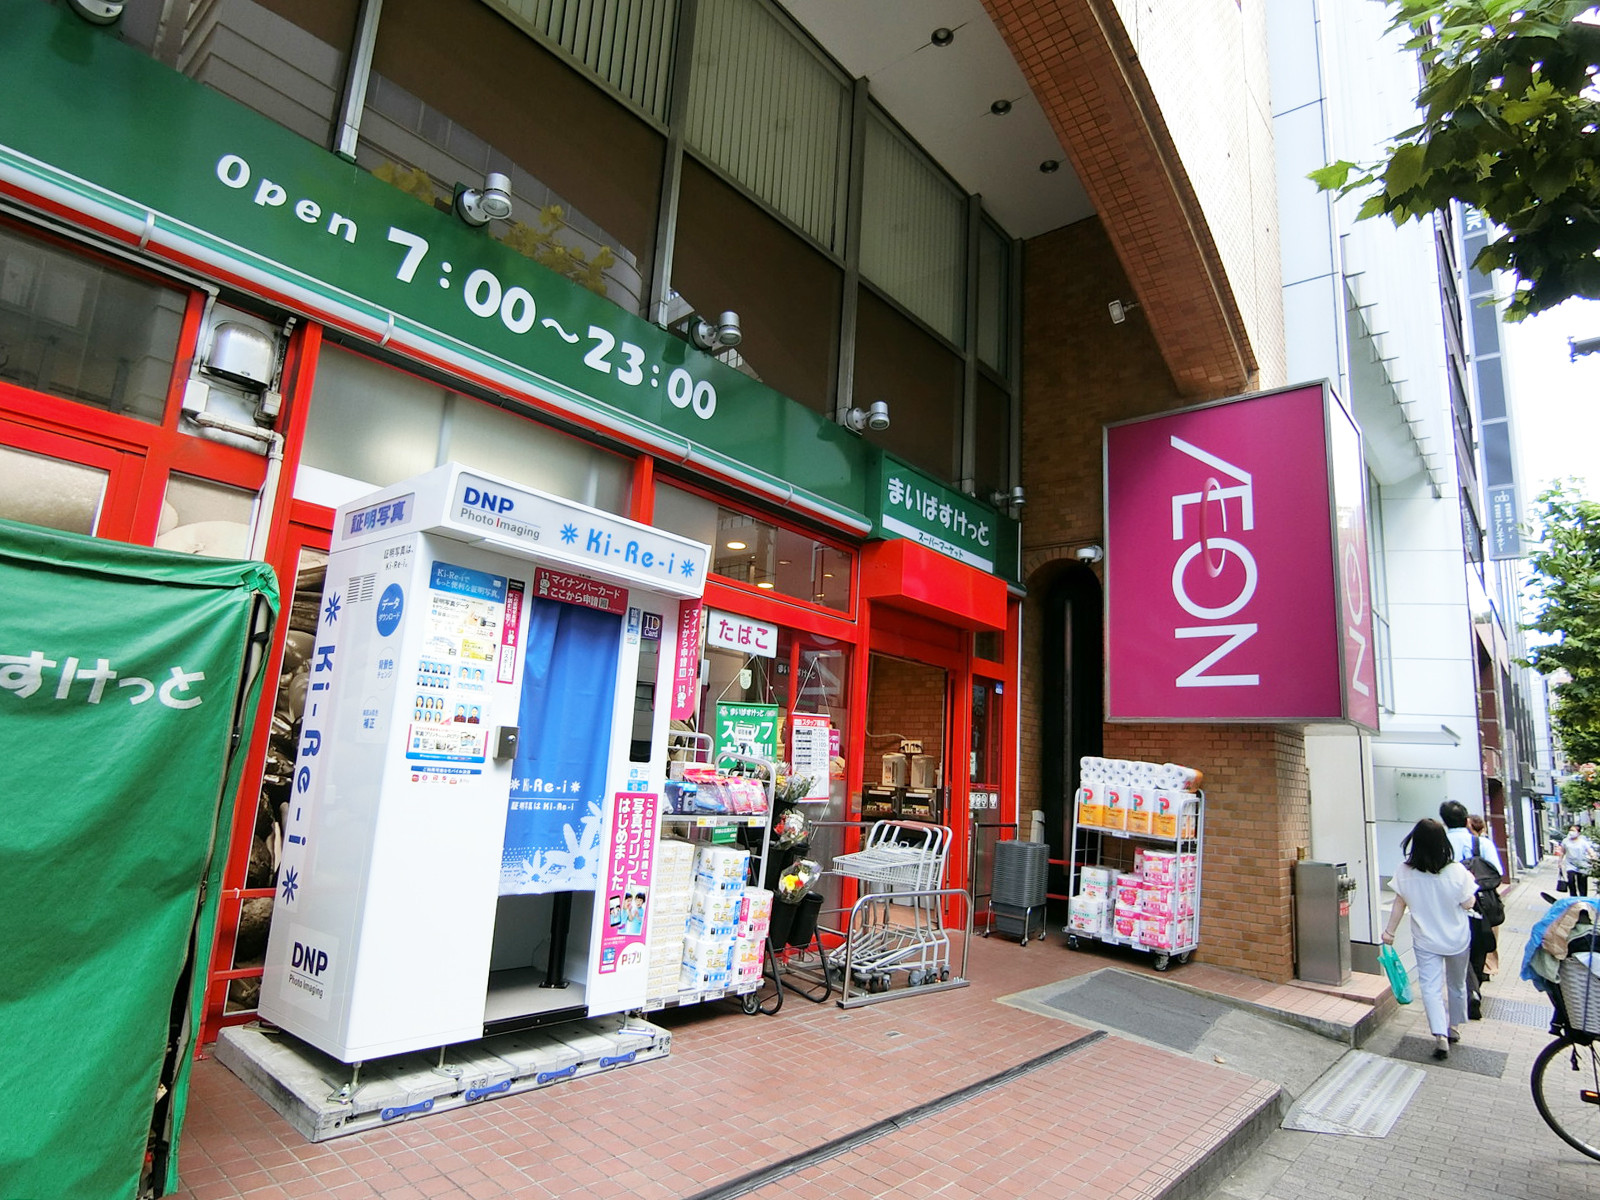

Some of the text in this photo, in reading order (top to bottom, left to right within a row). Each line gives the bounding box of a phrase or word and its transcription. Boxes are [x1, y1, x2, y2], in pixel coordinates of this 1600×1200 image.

[216, 154, 358, 244] Open
[350, 500, 406, 534] 証明写真
[463, 487, 514, 514] DNP
[887, 478, 990, 547] まいばすけっと
[460, 508, 541, 541] Photo Imaging
[586, 528, 675, 574] Ki-Re-i
[918, 532, 964, 559] スーパーマーケット
[1170, 435, 1260, 688] AEON
[382, 597, 400, 610] データ
[551, 575, 621, 599] マイナンバーカード
[643, 628, 659, 639] Card
[644, 614, 660, 631] ID
[718, 619, 769, 650] たばこ
[688, 609, 700, 697] マイナンバーカード
[288, 645, 336, 846] Ki-Re-i
[611, 798, 631, 891] はじめました
[627, 798, 645, 890] 写真プリント
[291, 941, 328, 976] DNP
